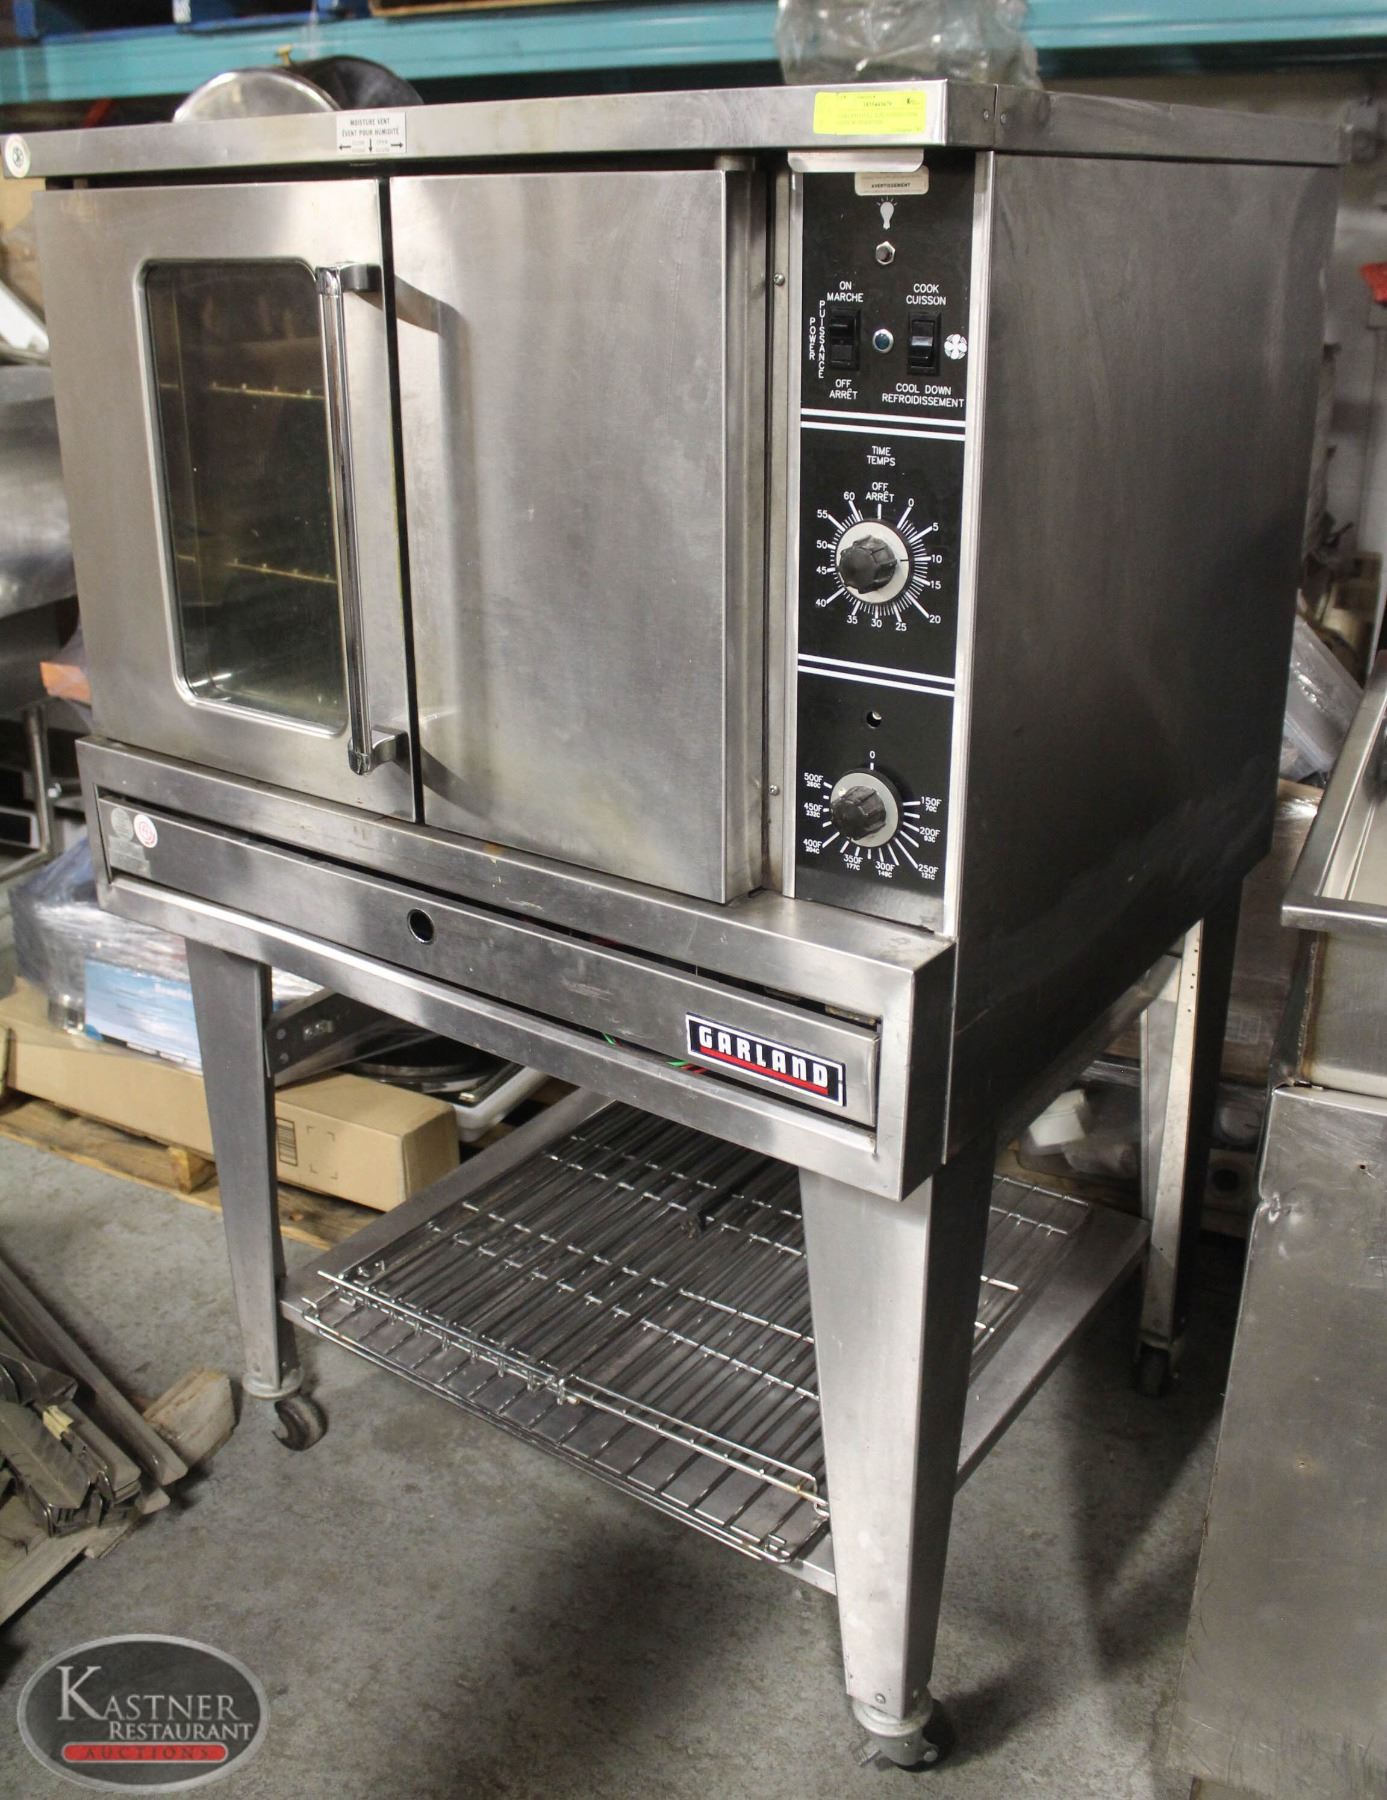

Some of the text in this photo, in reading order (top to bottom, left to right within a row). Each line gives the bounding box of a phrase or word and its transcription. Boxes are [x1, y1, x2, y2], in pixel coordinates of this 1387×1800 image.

[349, 118, 375, 126] MOISTURE
[839, 281, 852, 291] ON
[913, 283, 940, 293] COOK
[826, 292, 864, 303] MARCHE
[906, 295, 947, 306] CUISSON
[808, 317, 816, 361] POWER
[817, 300, 826, 379] PUISSANCE
[835, 379, 852, 388] OFF
[829, 387, 858, 400] ARRÊT
[895, 383, 952, 396] COOL DOWN
[881, 393, 966, 408] REFROIDISSEMENT
[871, 445, 892, 457] TIME
[866, 455, 896, 467] TEMPS
[871, 481, 889, 491] OFF
[843, 492, 855, 501] 60
[865, 491, 895, 503] ARRÊT
[908, 498, 915, 507] 0
[817, 509, 828, 519] 55
[932, 522, 939, 532] 5
[816, 540, 828, 549] 50
[931, 554, 943, 564] 10
[816, 566, 827, 575] 45
[930, 580, 942, 590] 15
[815, 598, 827, 608] 40
[846, 615, 858, 625] 35
[871, 618, 883, 628] 30
[929, 614, 942, 624] 20
[895, 622, 907, 632] 25
[803, 772, 824, 784] 500F
[803, 801, 823, 812] 450F
[921, 796, 942, 807] 150F
[919, 826, 941, 837] 200F
[803, 838, 823, 849] 400F
[843, 853, 863, 865] 350F
[875, 860, 896, 871] 300F
[918, 864, 939, 875] 250F
[698, 1025, 829, 1088] GARLAND
